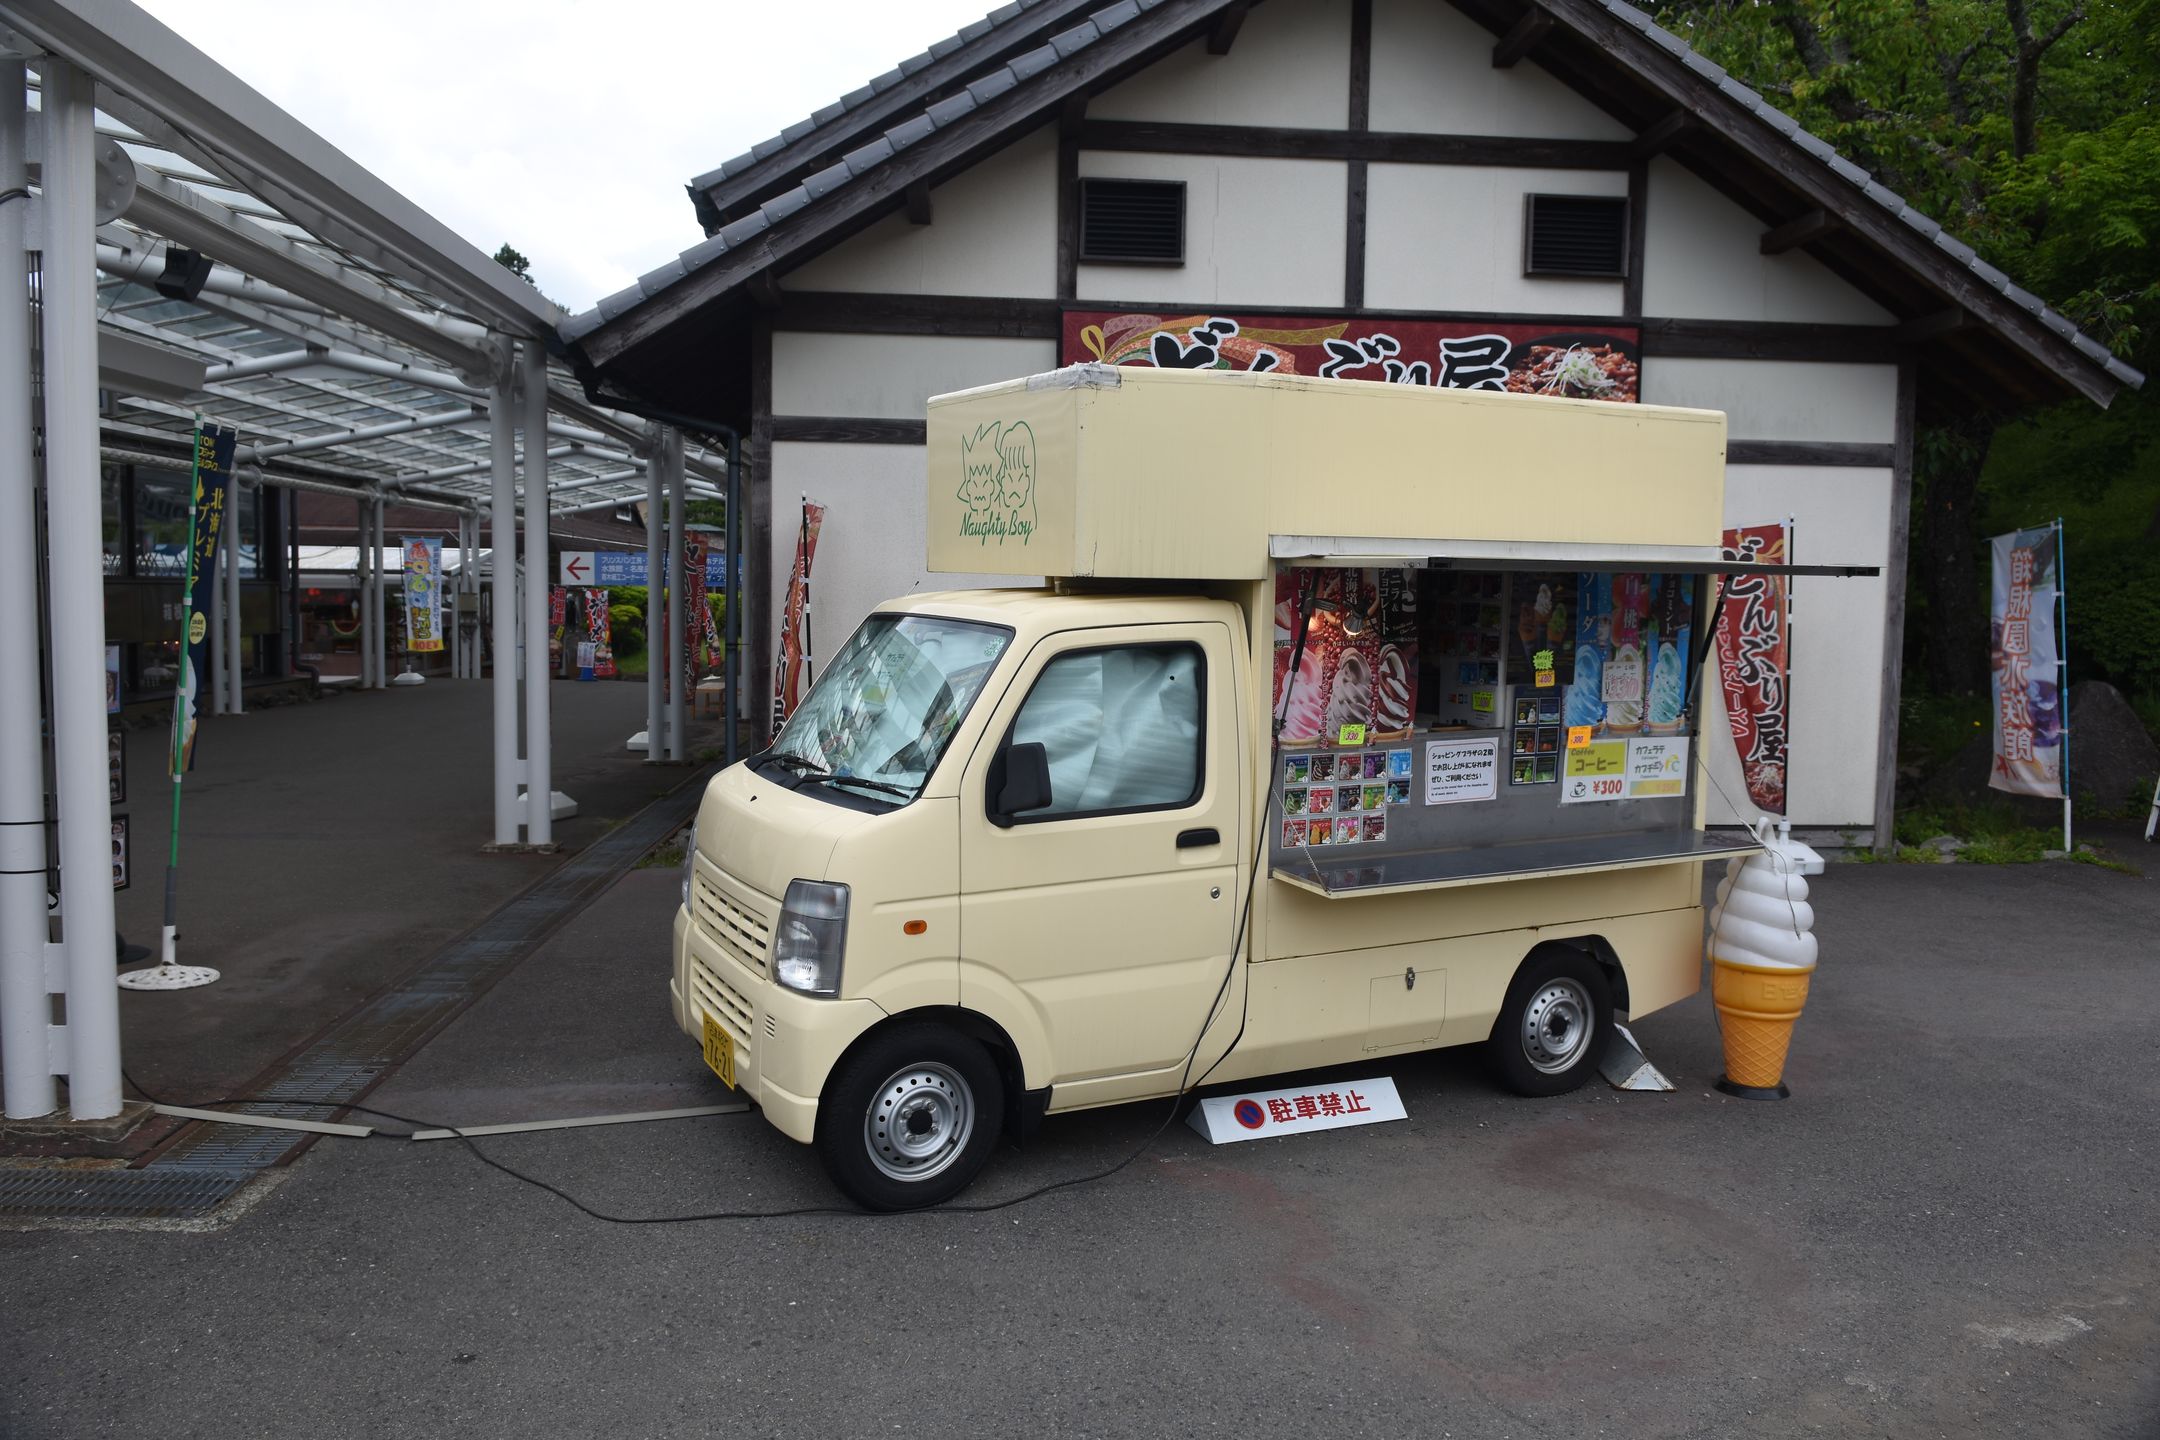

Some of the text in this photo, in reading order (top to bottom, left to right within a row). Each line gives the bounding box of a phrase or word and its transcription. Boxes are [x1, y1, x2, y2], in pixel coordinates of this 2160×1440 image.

[959, 509, 1033, 546] Naughty Boy
[1582, 573, 1597, 633] ソーダ
[1575, 757, 1618, 772] コーヒー
[1592, 779, 1623, 796] ¥300
[1267, 1089, 1371, 1123] 駐車禁止
